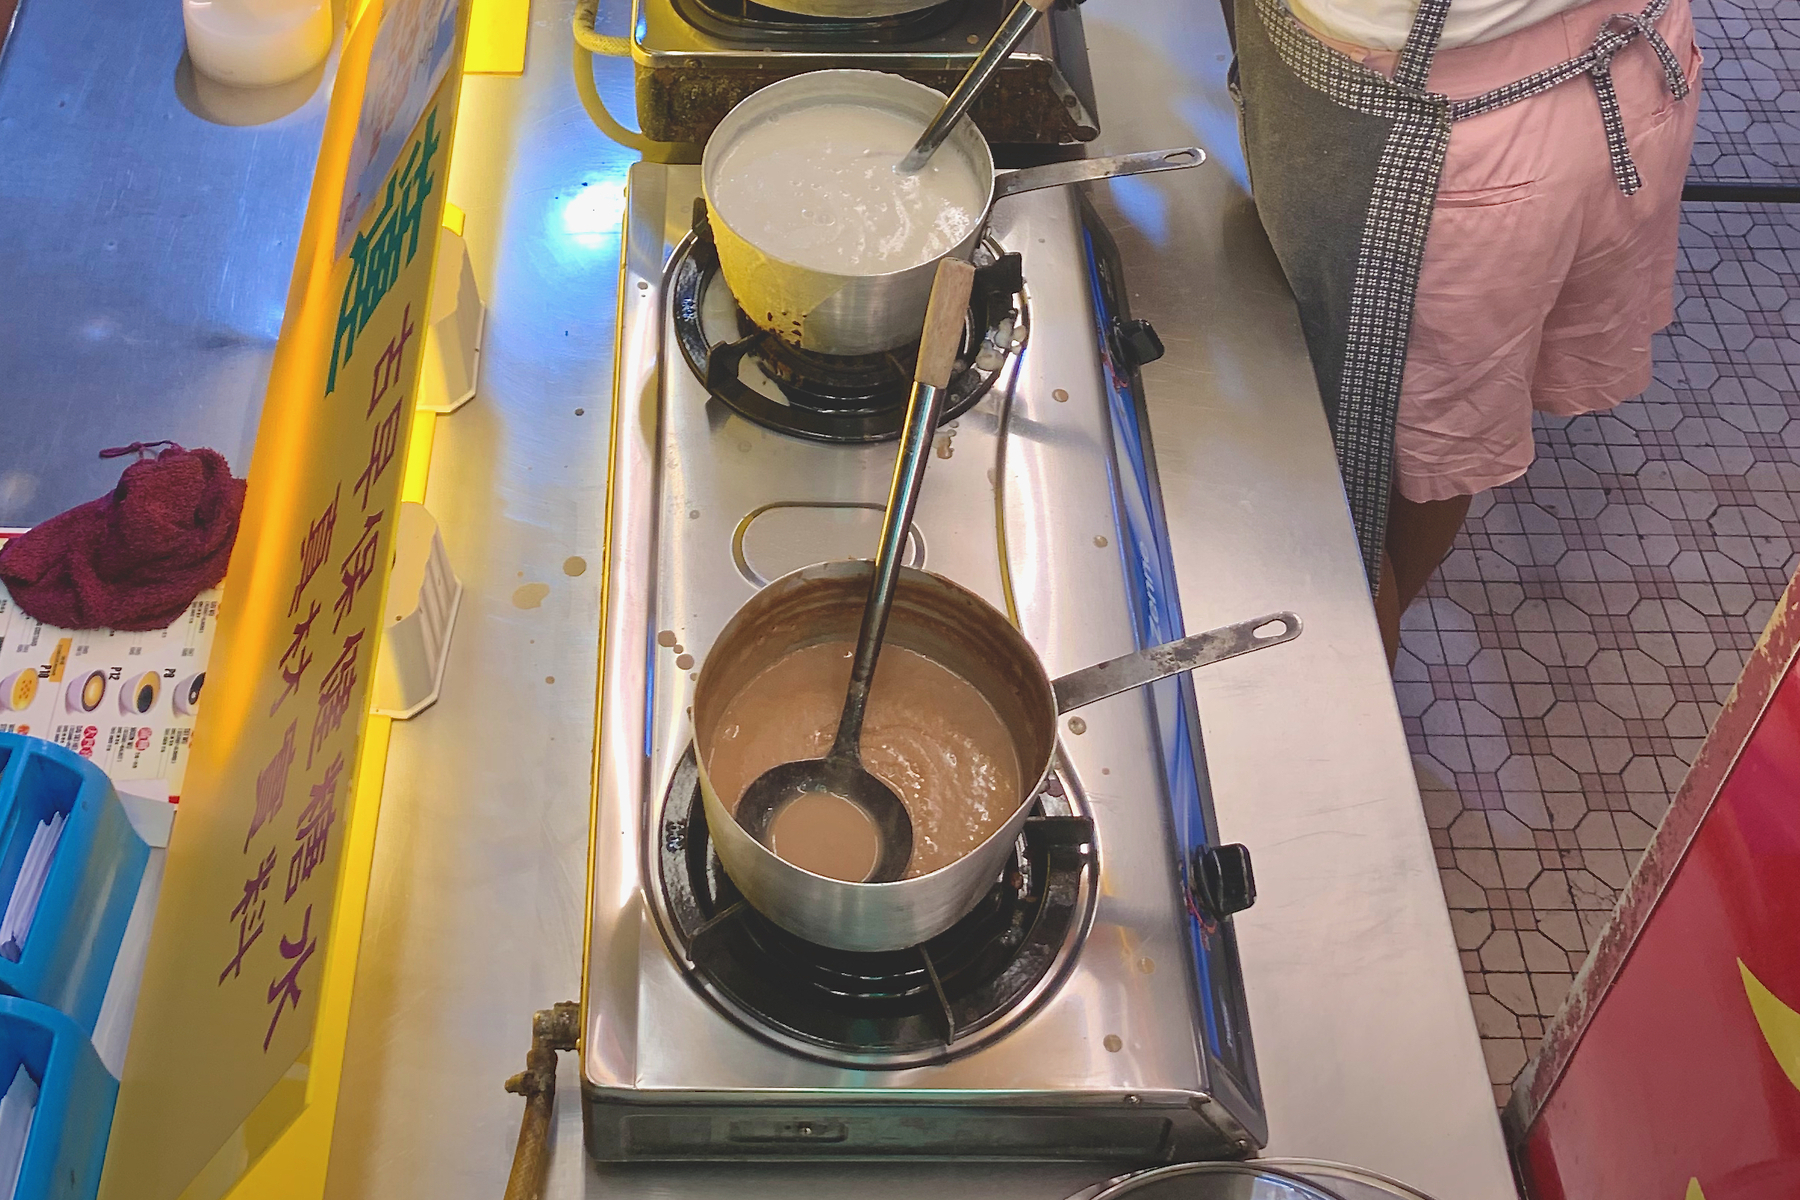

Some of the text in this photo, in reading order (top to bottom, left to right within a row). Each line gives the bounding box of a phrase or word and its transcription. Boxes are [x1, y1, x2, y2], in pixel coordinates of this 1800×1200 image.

[109, 666, 122, 681] P12
[218, 479, 342, 987] 真材實料
[263, 302, 414, 1053] 古早保健糖水
